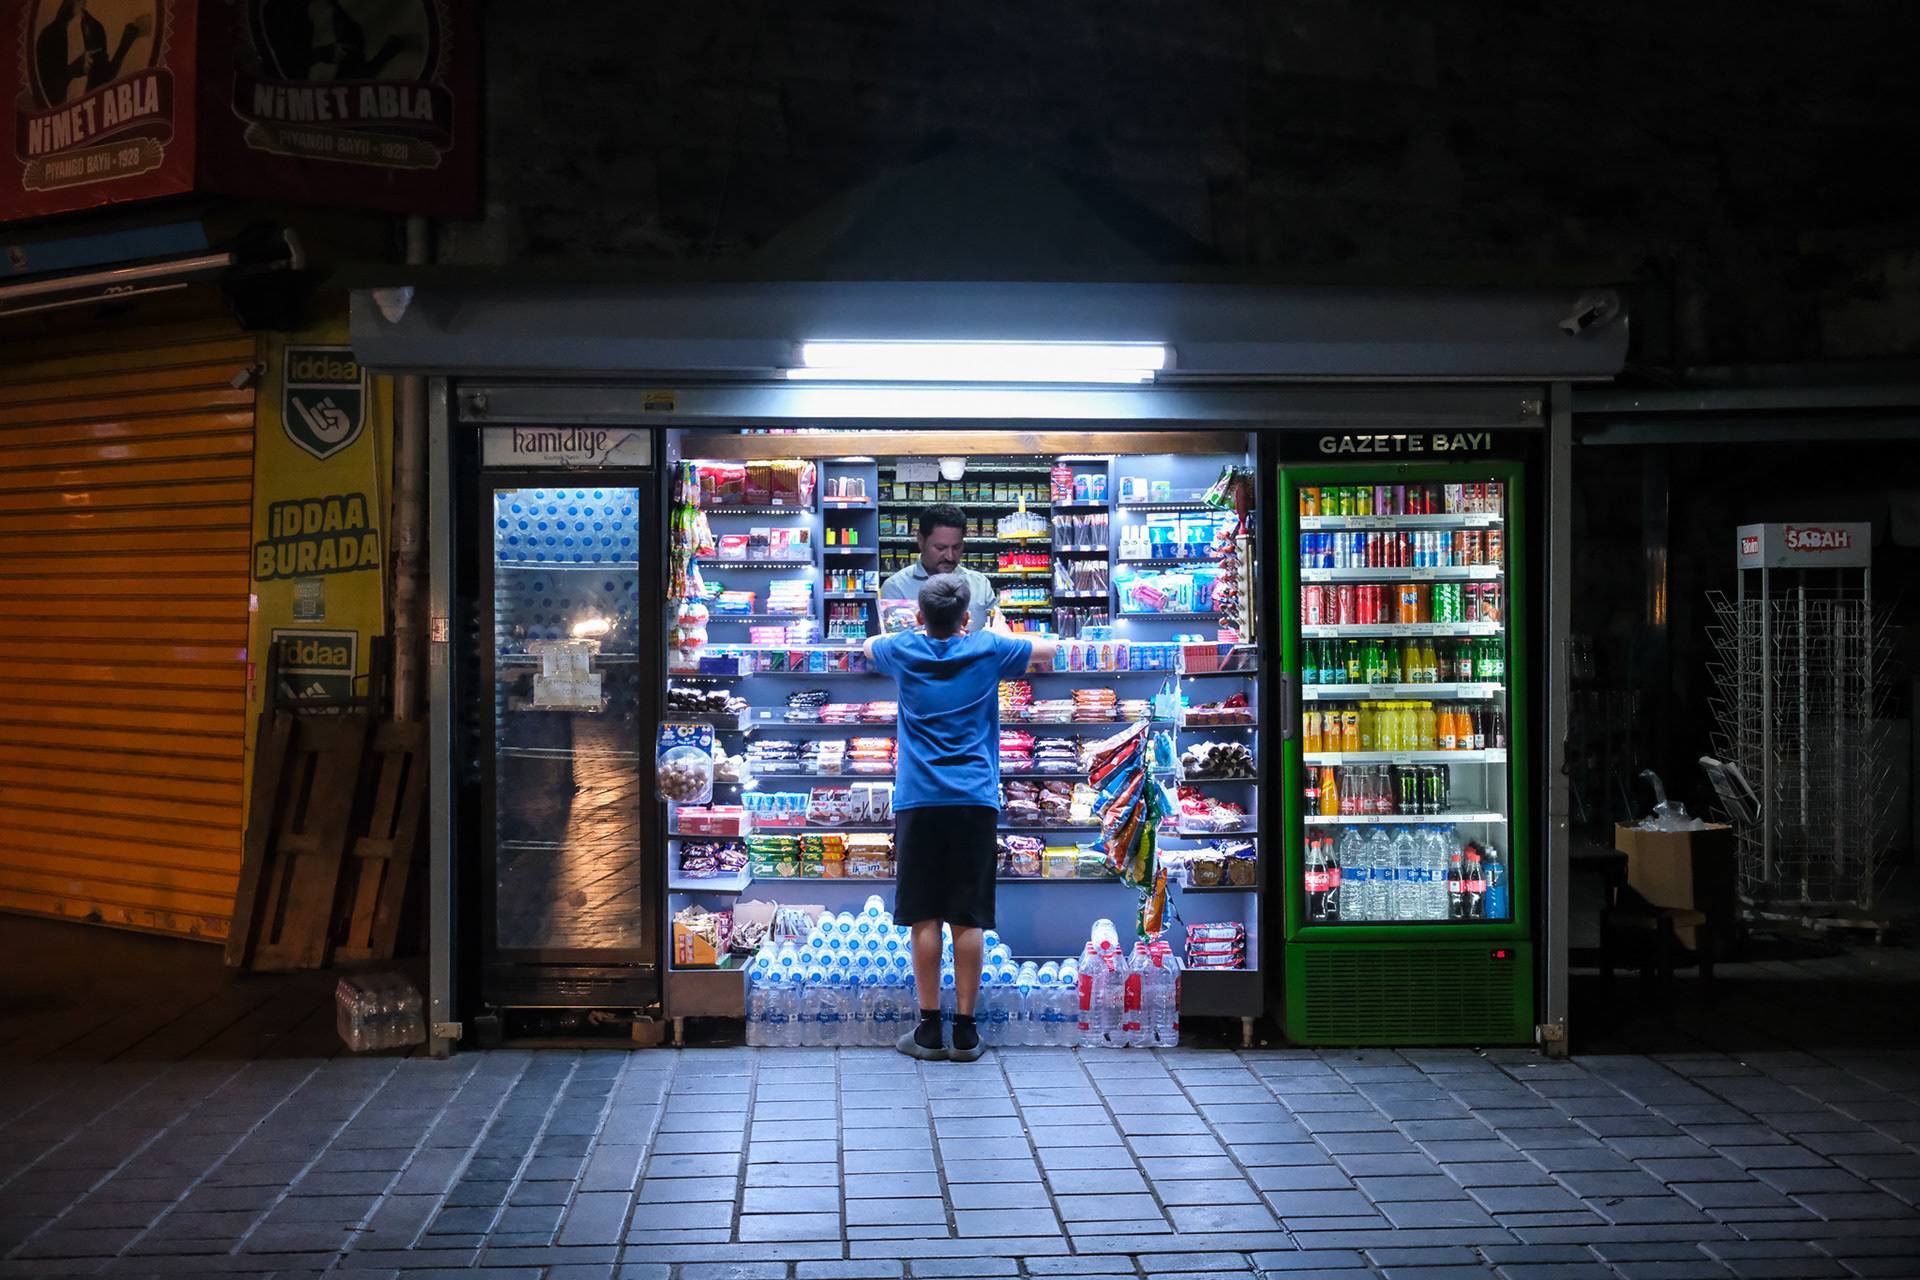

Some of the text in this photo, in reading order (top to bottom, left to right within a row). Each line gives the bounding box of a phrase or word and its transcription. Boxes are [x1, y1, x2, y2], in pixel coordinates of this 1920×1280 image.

[103, 76, 159, 129] ABLA
[359, 86, 434, 121] ABLA
[118, 147, 140, 168] 1928
[380, 142, 409, 160] 1928
[291, 355, 357, 380] iddaa
[513, 428, 607, 459] hamidiye
[1319, 434, 1424, 454] GAZETE
[1787, 530, 1848, 548] SABAH
[256, 533, 379, 577] BURADA
[280, 639, 348, 665] iddaa
